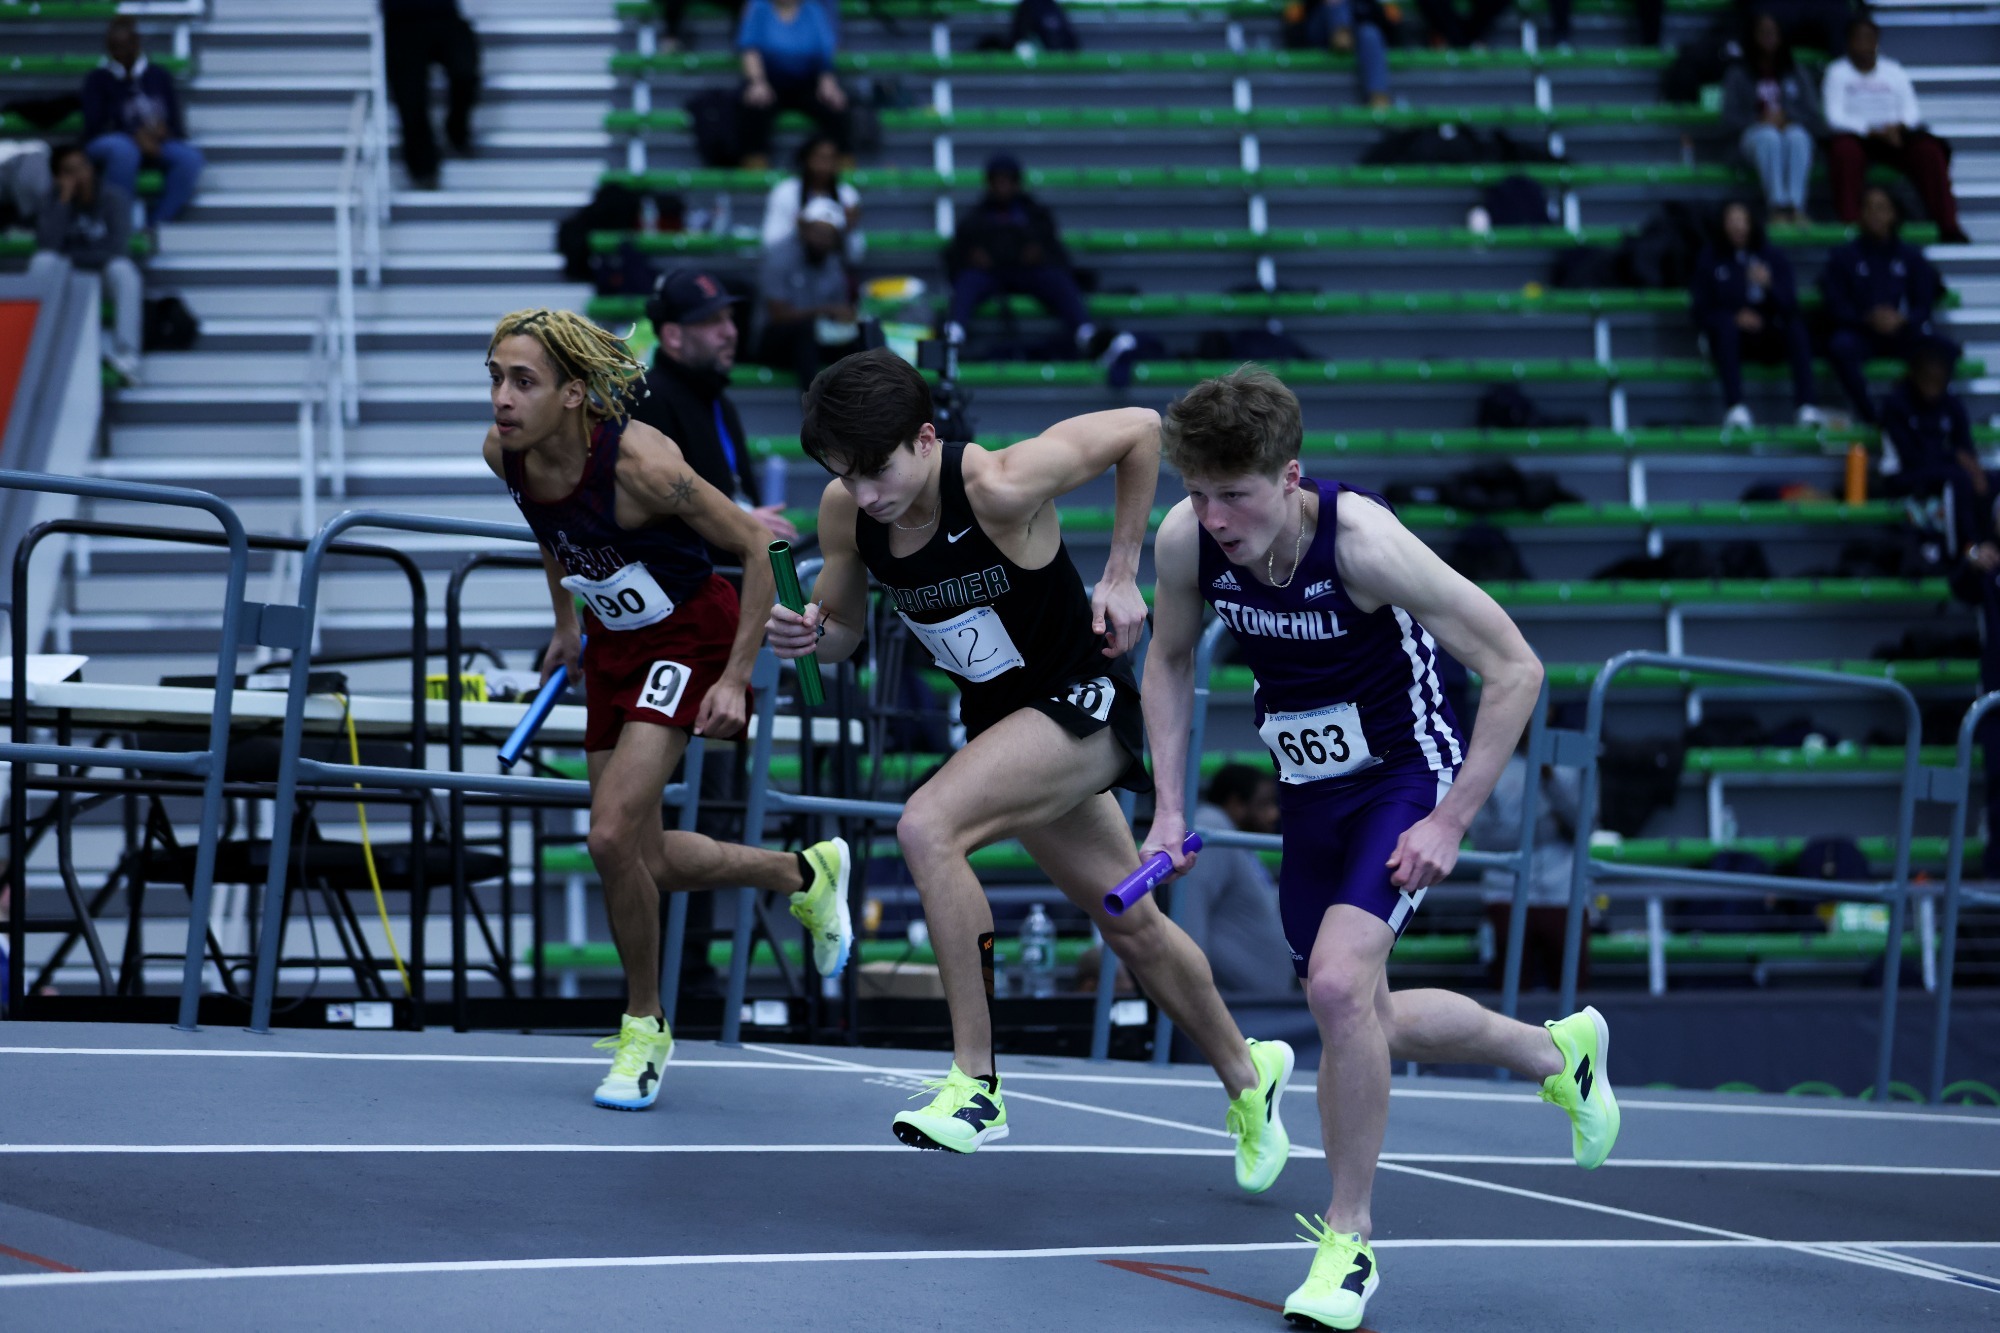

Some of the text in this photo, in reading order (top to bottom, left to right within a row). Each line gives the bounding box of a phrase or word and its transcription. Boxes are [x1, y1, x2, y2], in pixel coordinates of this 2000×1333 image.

[1212, 581, 1242, 592] adidas
[1304, 579, 1333, 600] NEC
[939, 615, 978, 634] CONFERENCE
[1214, 599, 1348, 640] STONEHILL
[646, 664, 682, 707] 9
[1299, 707, 1338, 719] CONFERENCE
[1278, 724, 1350, 766] 663
